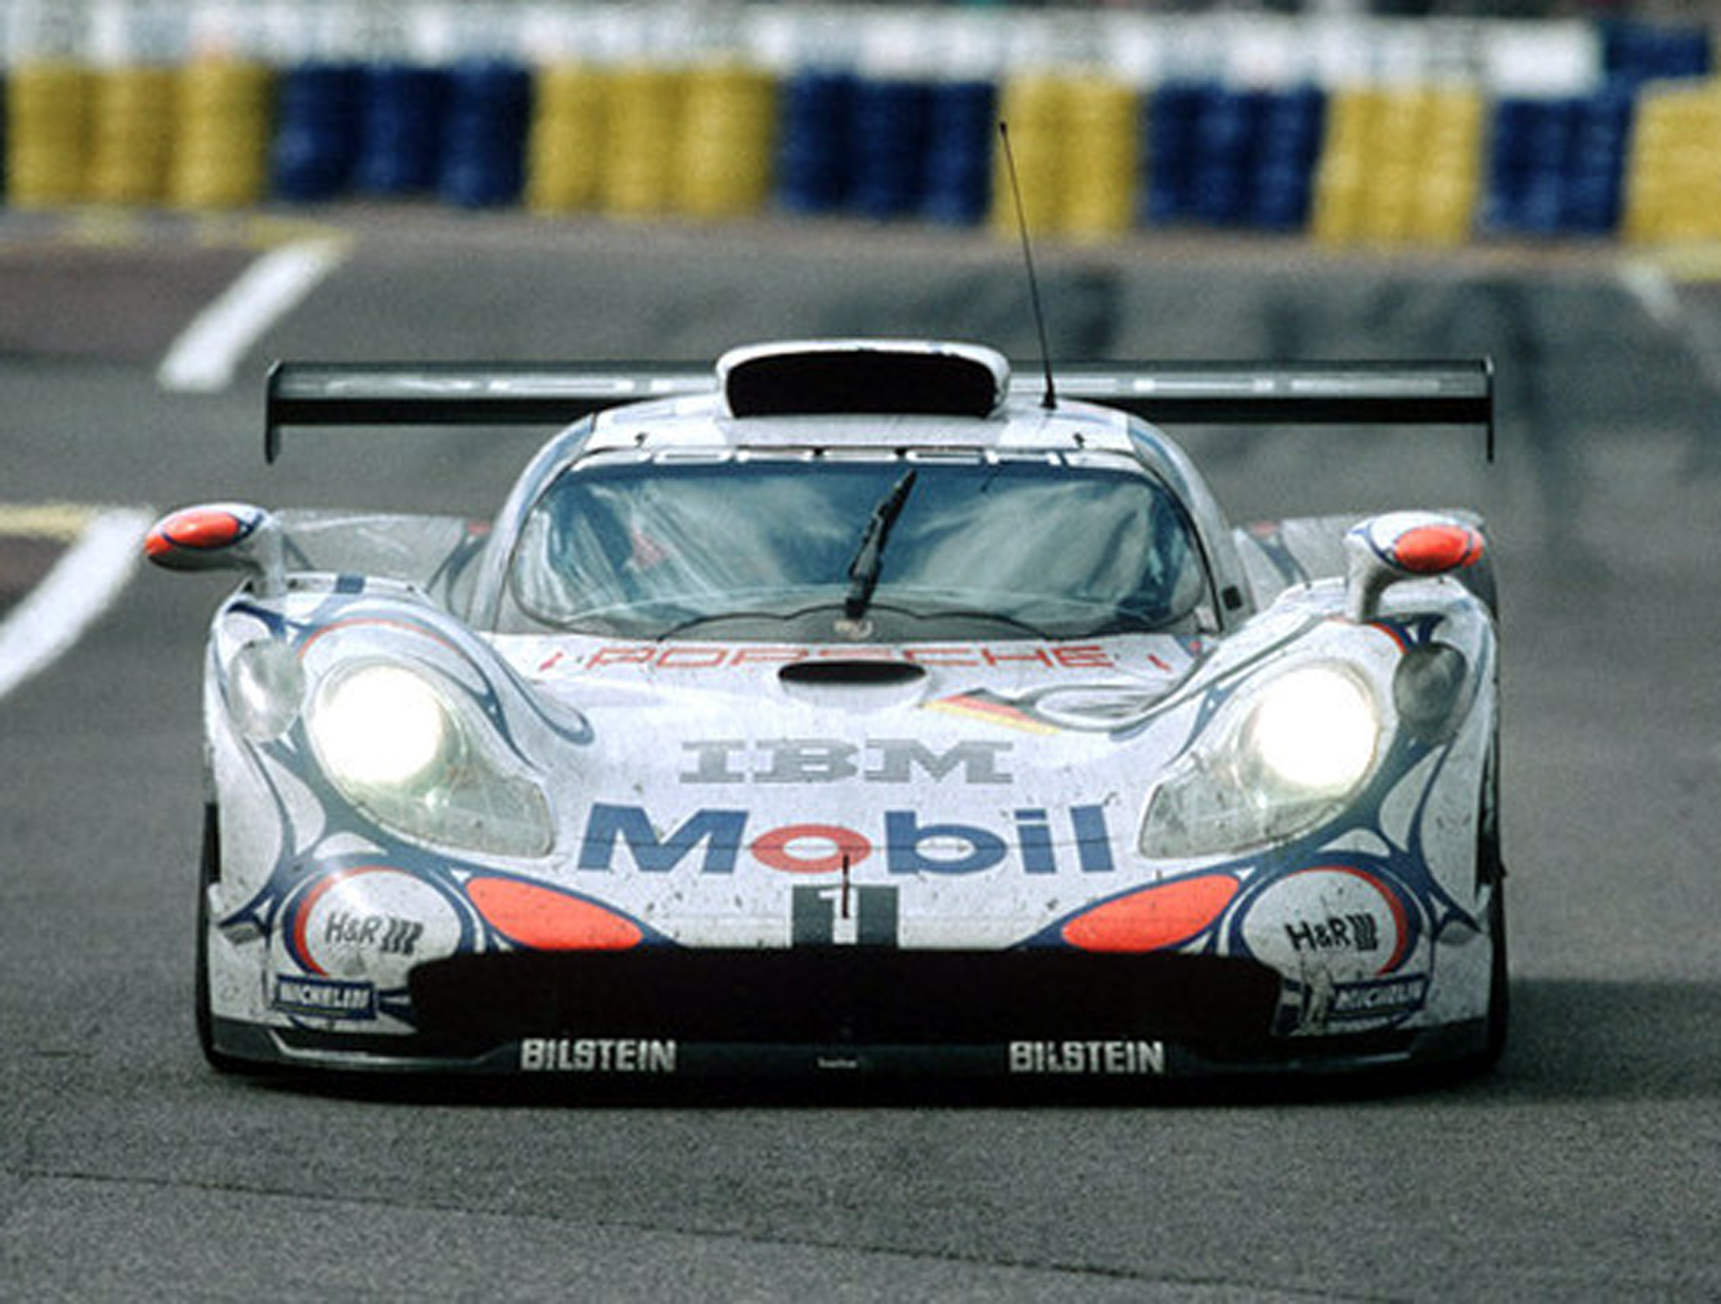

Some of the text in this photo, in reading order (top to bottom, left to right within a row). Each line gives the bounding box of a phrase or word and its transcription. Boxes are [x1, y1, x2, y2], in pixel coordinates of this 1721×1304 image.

[679, 738, 1013, 784] IBM
[577, 803, 1115, 875] Mobil
[324, 913, 383, 944] H&R
[1284, 913, 1349, 951] H&R
[521, 1038, 676, 1072] BILSTEIN
[1009, 1040, 1164, 1073] BILSTEIN
